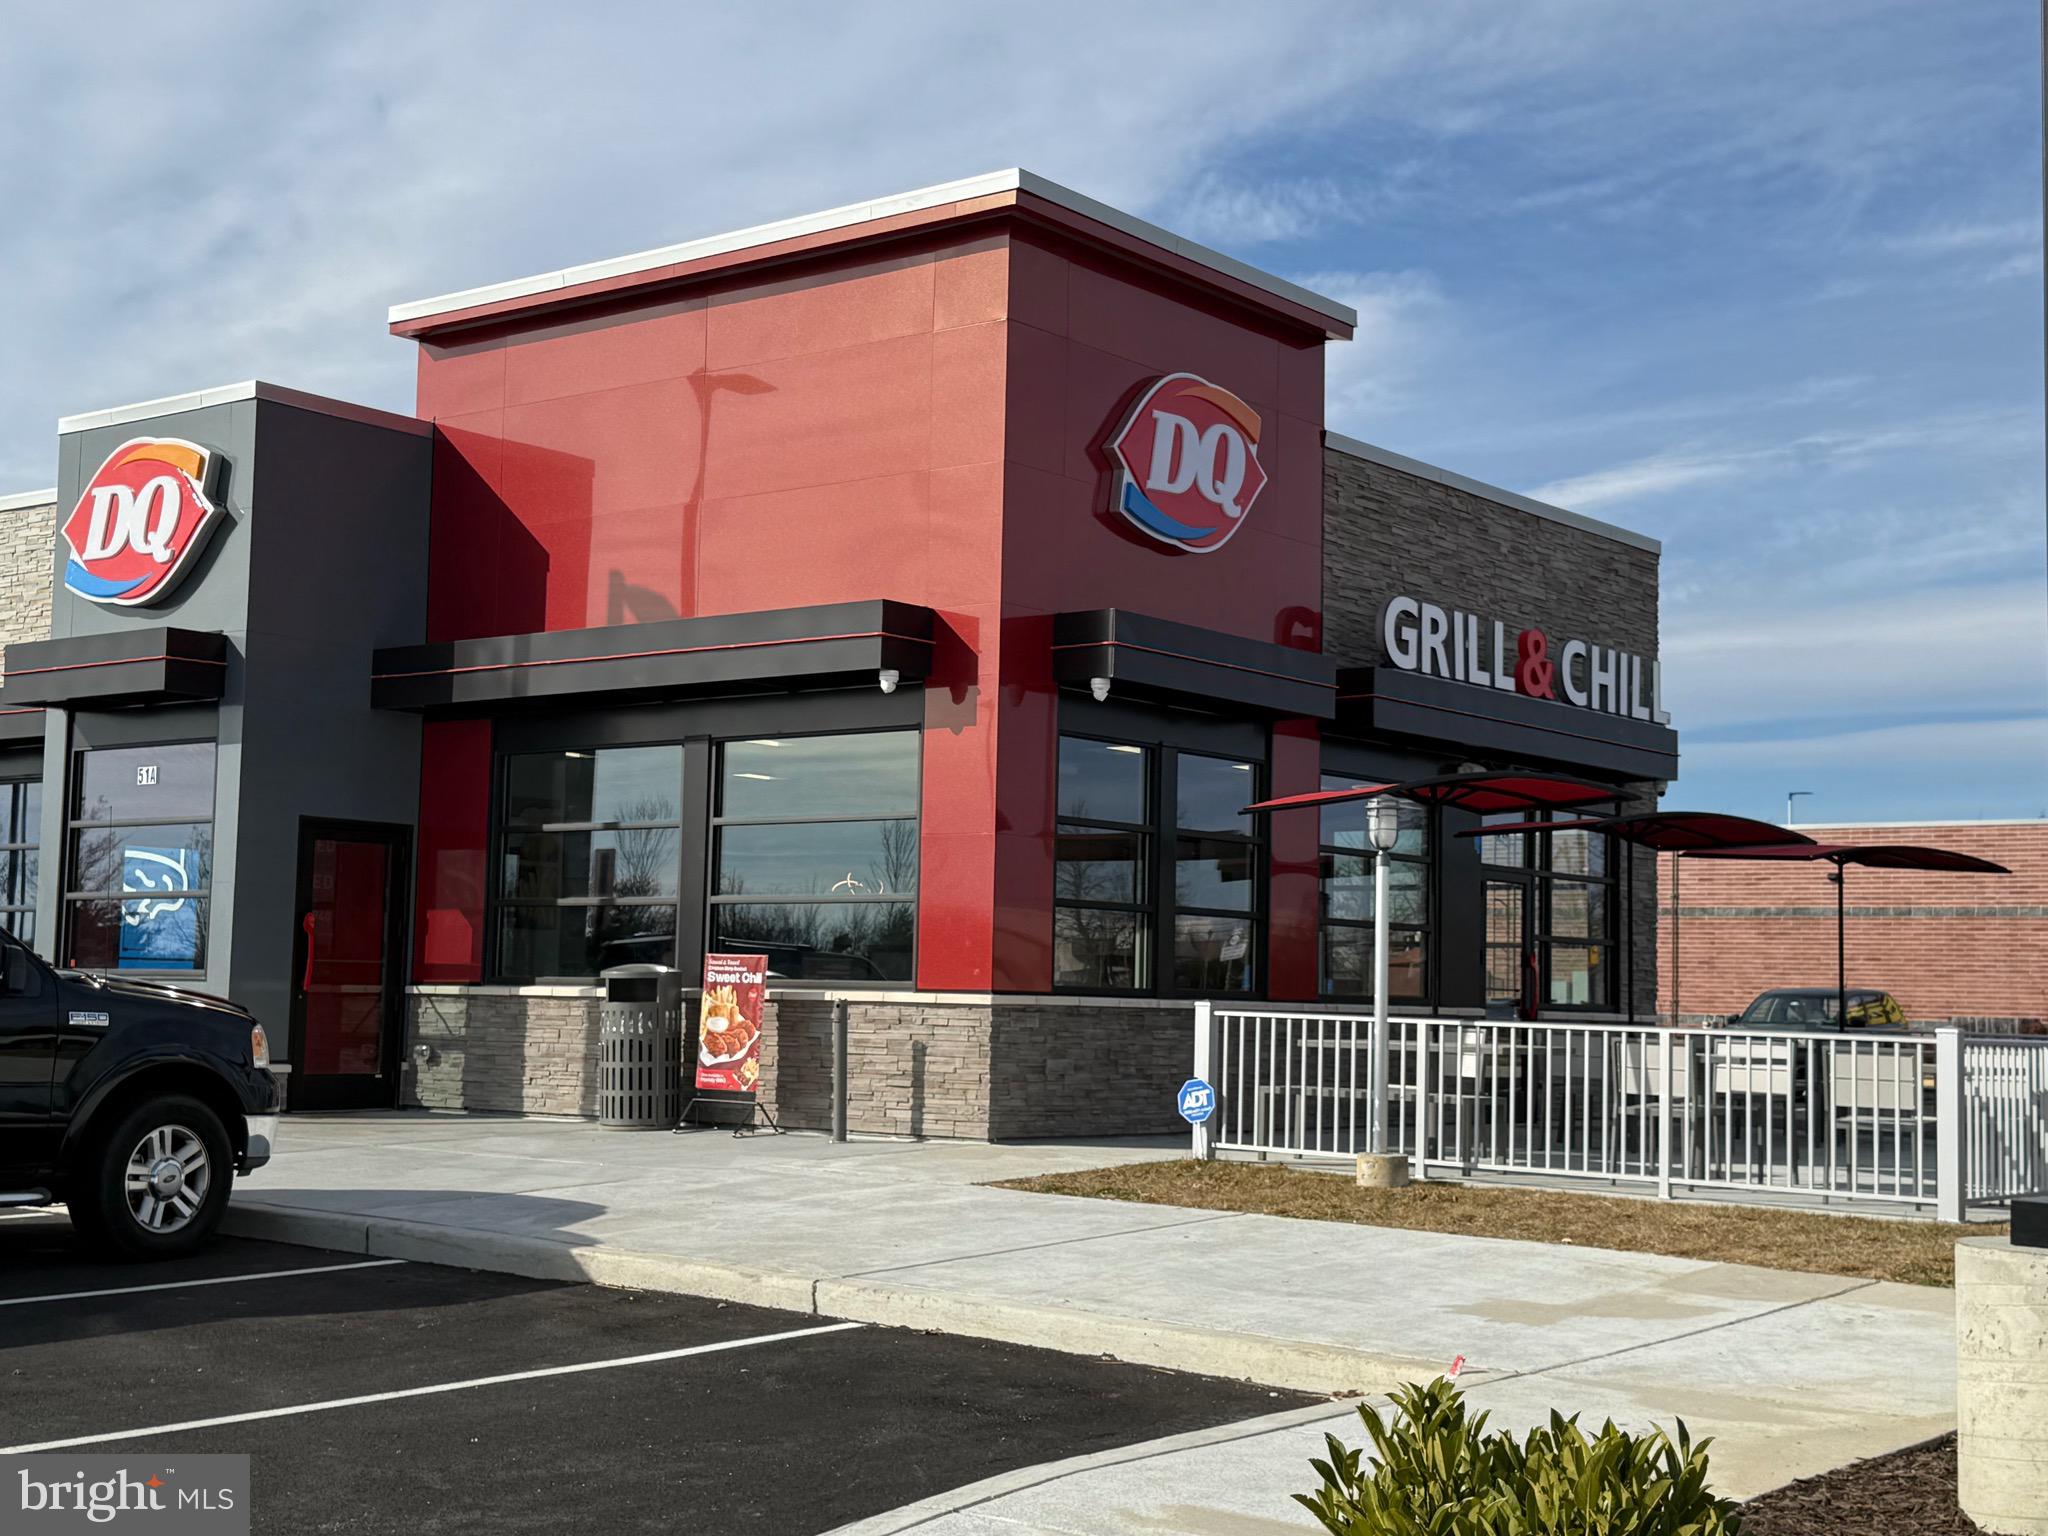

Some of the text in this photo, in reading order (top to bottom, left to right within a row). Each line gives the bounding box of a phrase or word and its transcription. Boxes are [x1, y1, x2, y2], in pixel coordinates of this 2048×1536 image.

[1146, 409, 1247, 518] DQ
[82, 475, 181, 563] DQ
[1383, 596, 1670, 725] GRILL & CHILL
[138, 767, 156, 784] 51A
[708, 972, 740, 983] Sweet
[1182, 1088, 1210, 1110] ADT
